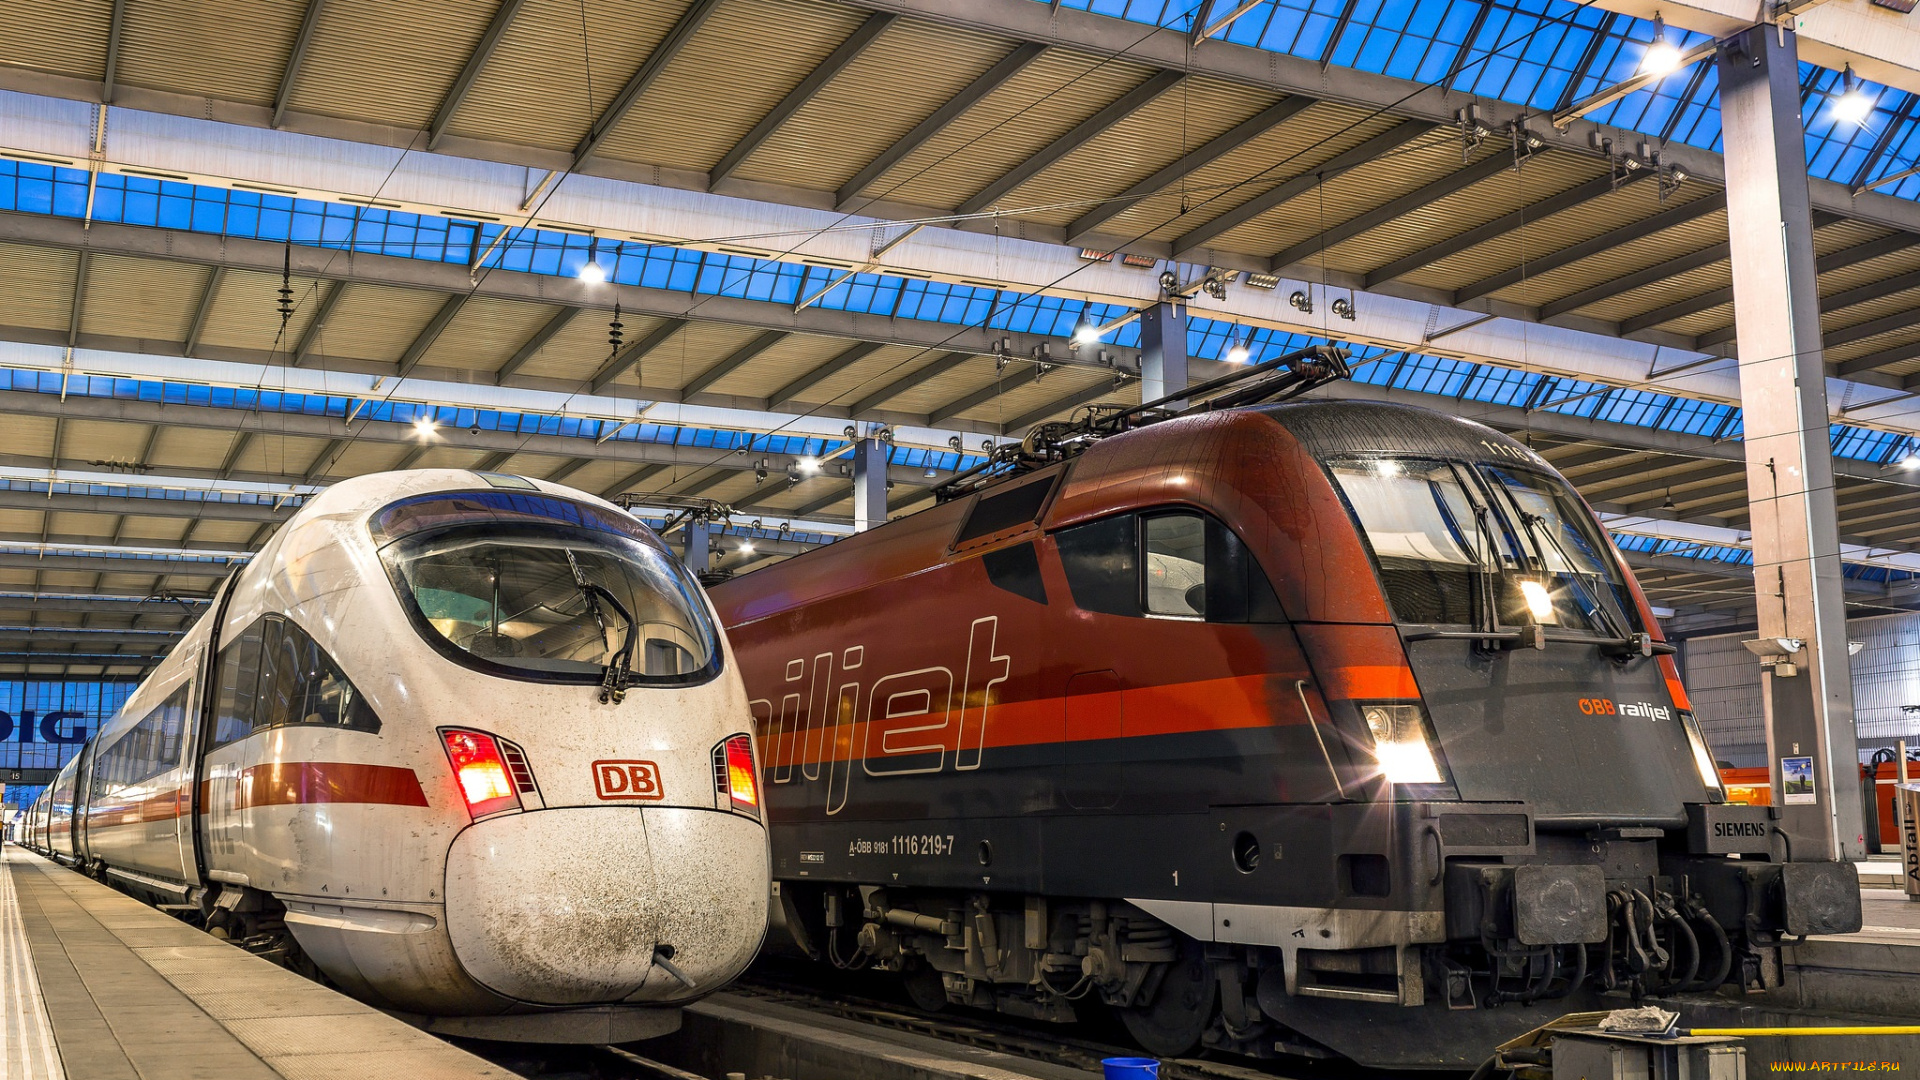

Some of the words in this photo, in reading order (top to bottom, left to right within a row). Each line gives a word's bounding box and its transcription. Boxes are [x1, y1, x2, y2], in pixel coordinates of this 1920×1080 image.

[1480, 440, 1530, 462] 1116
[749, 615, 1011, 816] iljet
[1578, 698, 1616, 716] ÖBB
[1618, 701, 1671, 722] railjet
[11, 772, 20, 780] 15
[601, 766, 655, 793] DB
[1714, 822, 1765, 837] SIEMENS
[873, 841, 889, 854] 9181
[892, 834, 919, 855] 1116
[920, 834, 954, 855] 219-7
[1904, 819, 1920, 882] Abfall
[1172, 870, 1178, 887] 1
